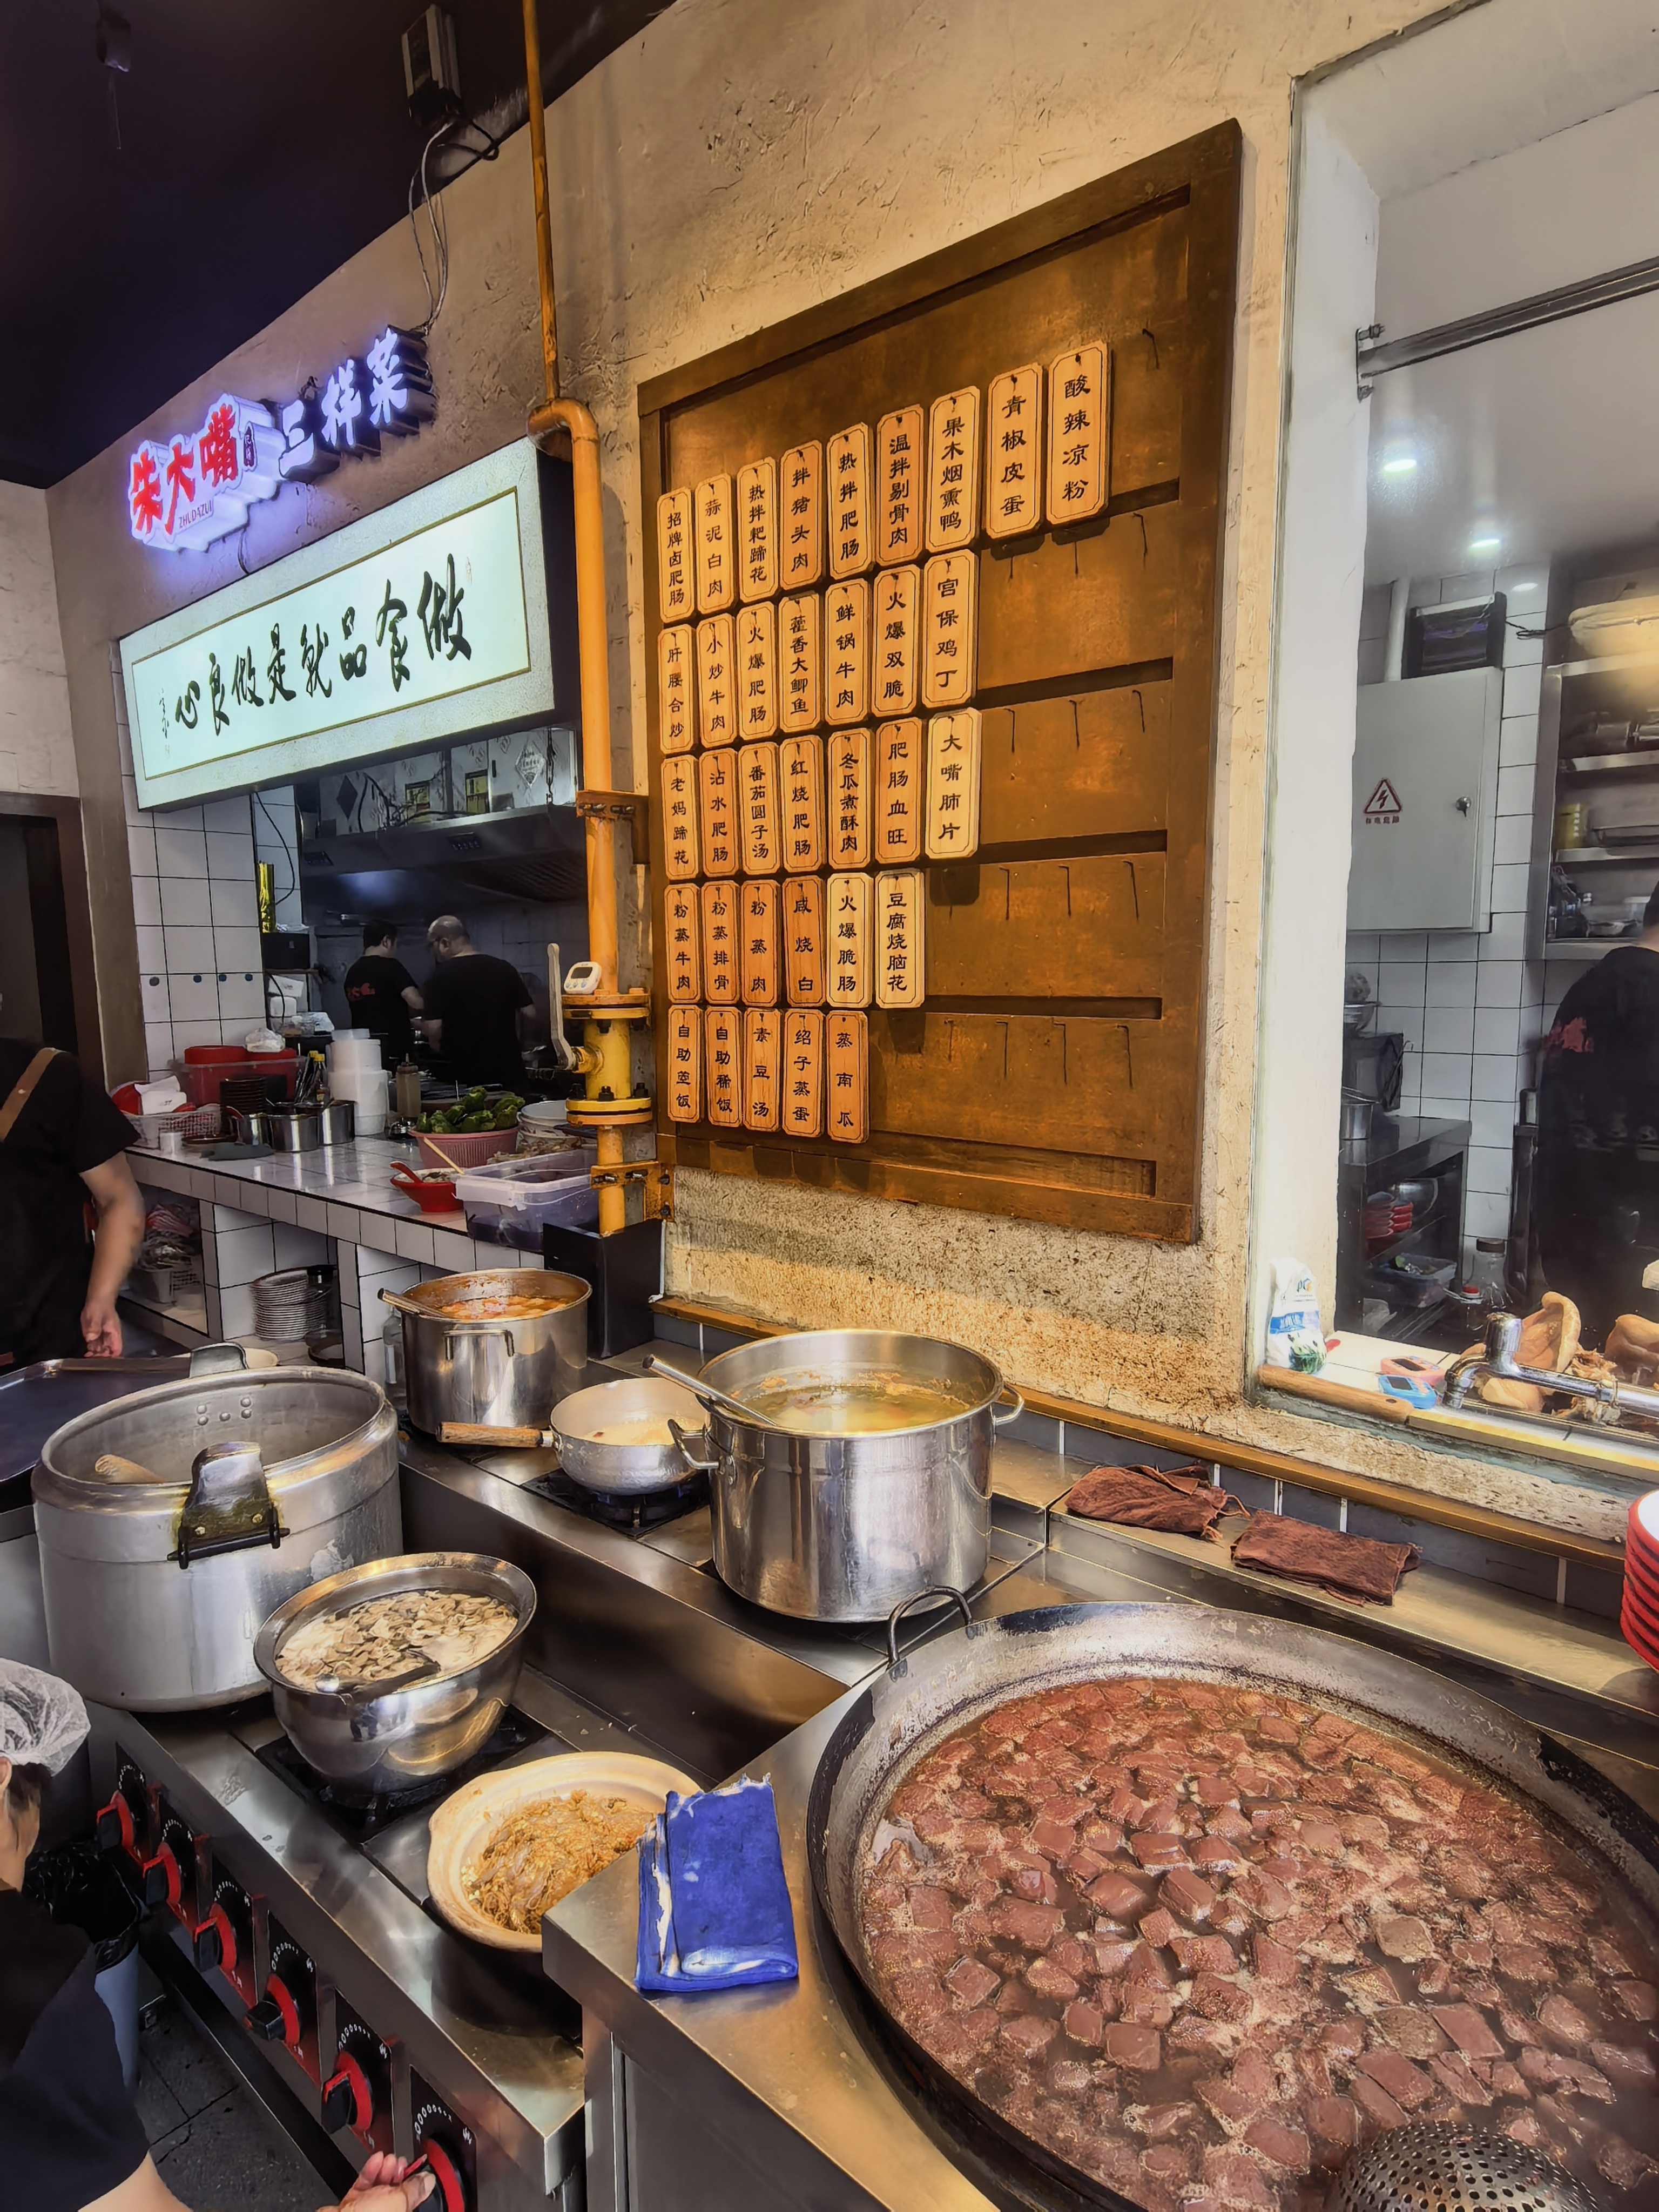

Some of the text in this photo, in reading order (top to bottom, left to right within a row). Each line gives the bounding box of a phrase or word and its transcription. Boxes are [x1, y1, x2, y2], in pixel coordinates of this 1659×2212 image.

[279, 327, 407, 475] 三样菜
[1061, 374, 1091, 502] 酸辣凉粉
[887, 433, 911, 549] 温拌剔骨肉
[939, 416, 965, 532] 果木烟熏鸭
[1000, 395, 1027, 517] 青椒皮蛋
[179, 500, 212, 528] ZHUDAZUI
[705, 500, 723, 598] 蒜泥白肉
[790, 467, 811, 573] 拌猪头肉
[838, 451, 860, 561] 热拌肥肠
[666, 511, 685, 607] 招牌卤肥肠
[747, 625, 767, 724] 火爆肥肠
[789, 615, 809, 715] 藿香大鲫鱼
[835, 603, 856, 709] 鲜锅牛肉
[882, 591, 907, 699] 火爆双脆
[935, 578, 959, 688] 宫保鸡丁
[667, 647, 685, 738] 肝腰合炒
[706, 637, 726, 732] 小炒牛肉
[670, 777, 689, 865] 老妈蹄花
[709, 768, 729, 863] 沾水肥肠
[790, 759, 811, 857] 红烧肥肠
[839, 752, 859, 853] 冬瓜煮酥肉
[887, 741, 909, 845] 肥肠血旺
[938, 733, 963, 840] 大嘴肺片
[673, 903, 691, 990] 粉蒸牛肉
[711, 901, 730, 990] 粉蒸排骨
[750, 900, 767, 993] 粉蒸肉
[793, 895, 814, 992] 咸烧白
[837, 894, 858, 992] 火爆脆肠
[886, 892, 908, 992] 豆腐烧脑花
[752, 1027, 771, 1118] 素豆汤
[792, 1029, 812, 1122] 绍子蒸蛋
[835, 1031, 854, 1128] 蒸南瓜
